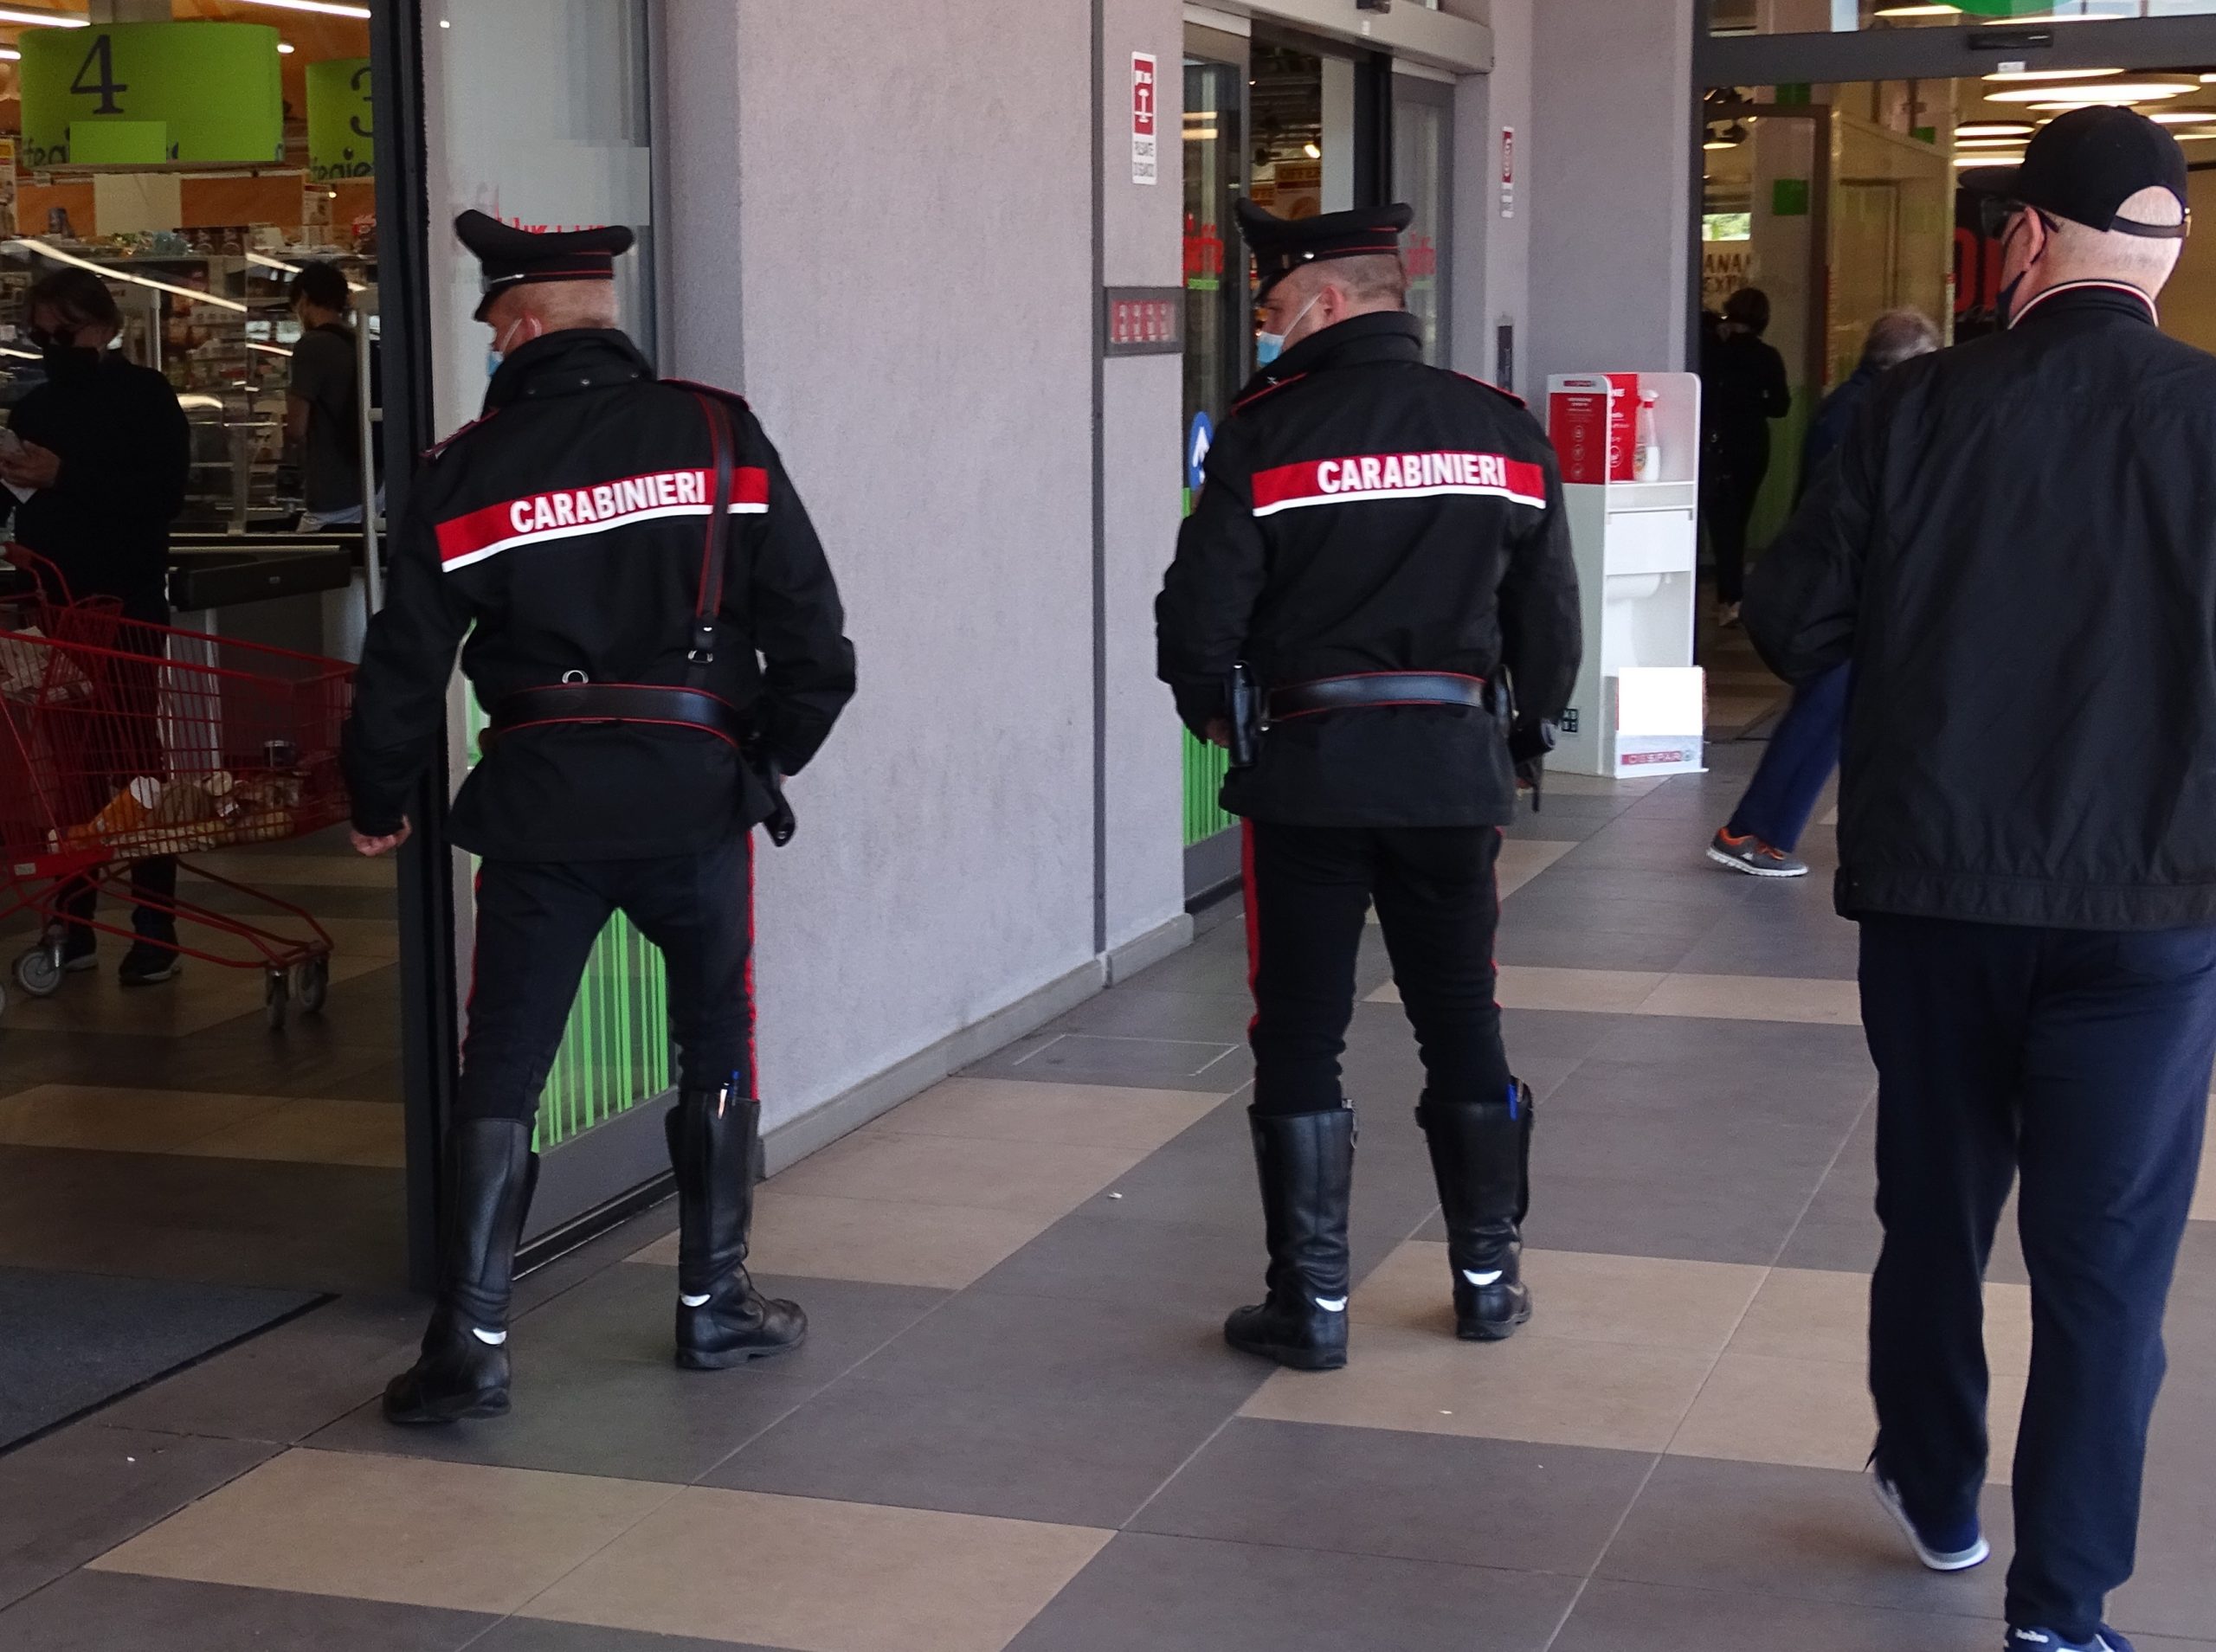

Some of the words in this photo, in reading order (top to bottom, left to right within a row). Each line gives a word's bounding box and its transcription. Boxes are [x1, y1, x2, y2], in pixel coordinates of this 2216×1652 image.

[70, 35, 127, 115] 4
[510, 471, 706, 534] CARABINIERI
[1317, 453, 1507, 494] CARABINIERI
